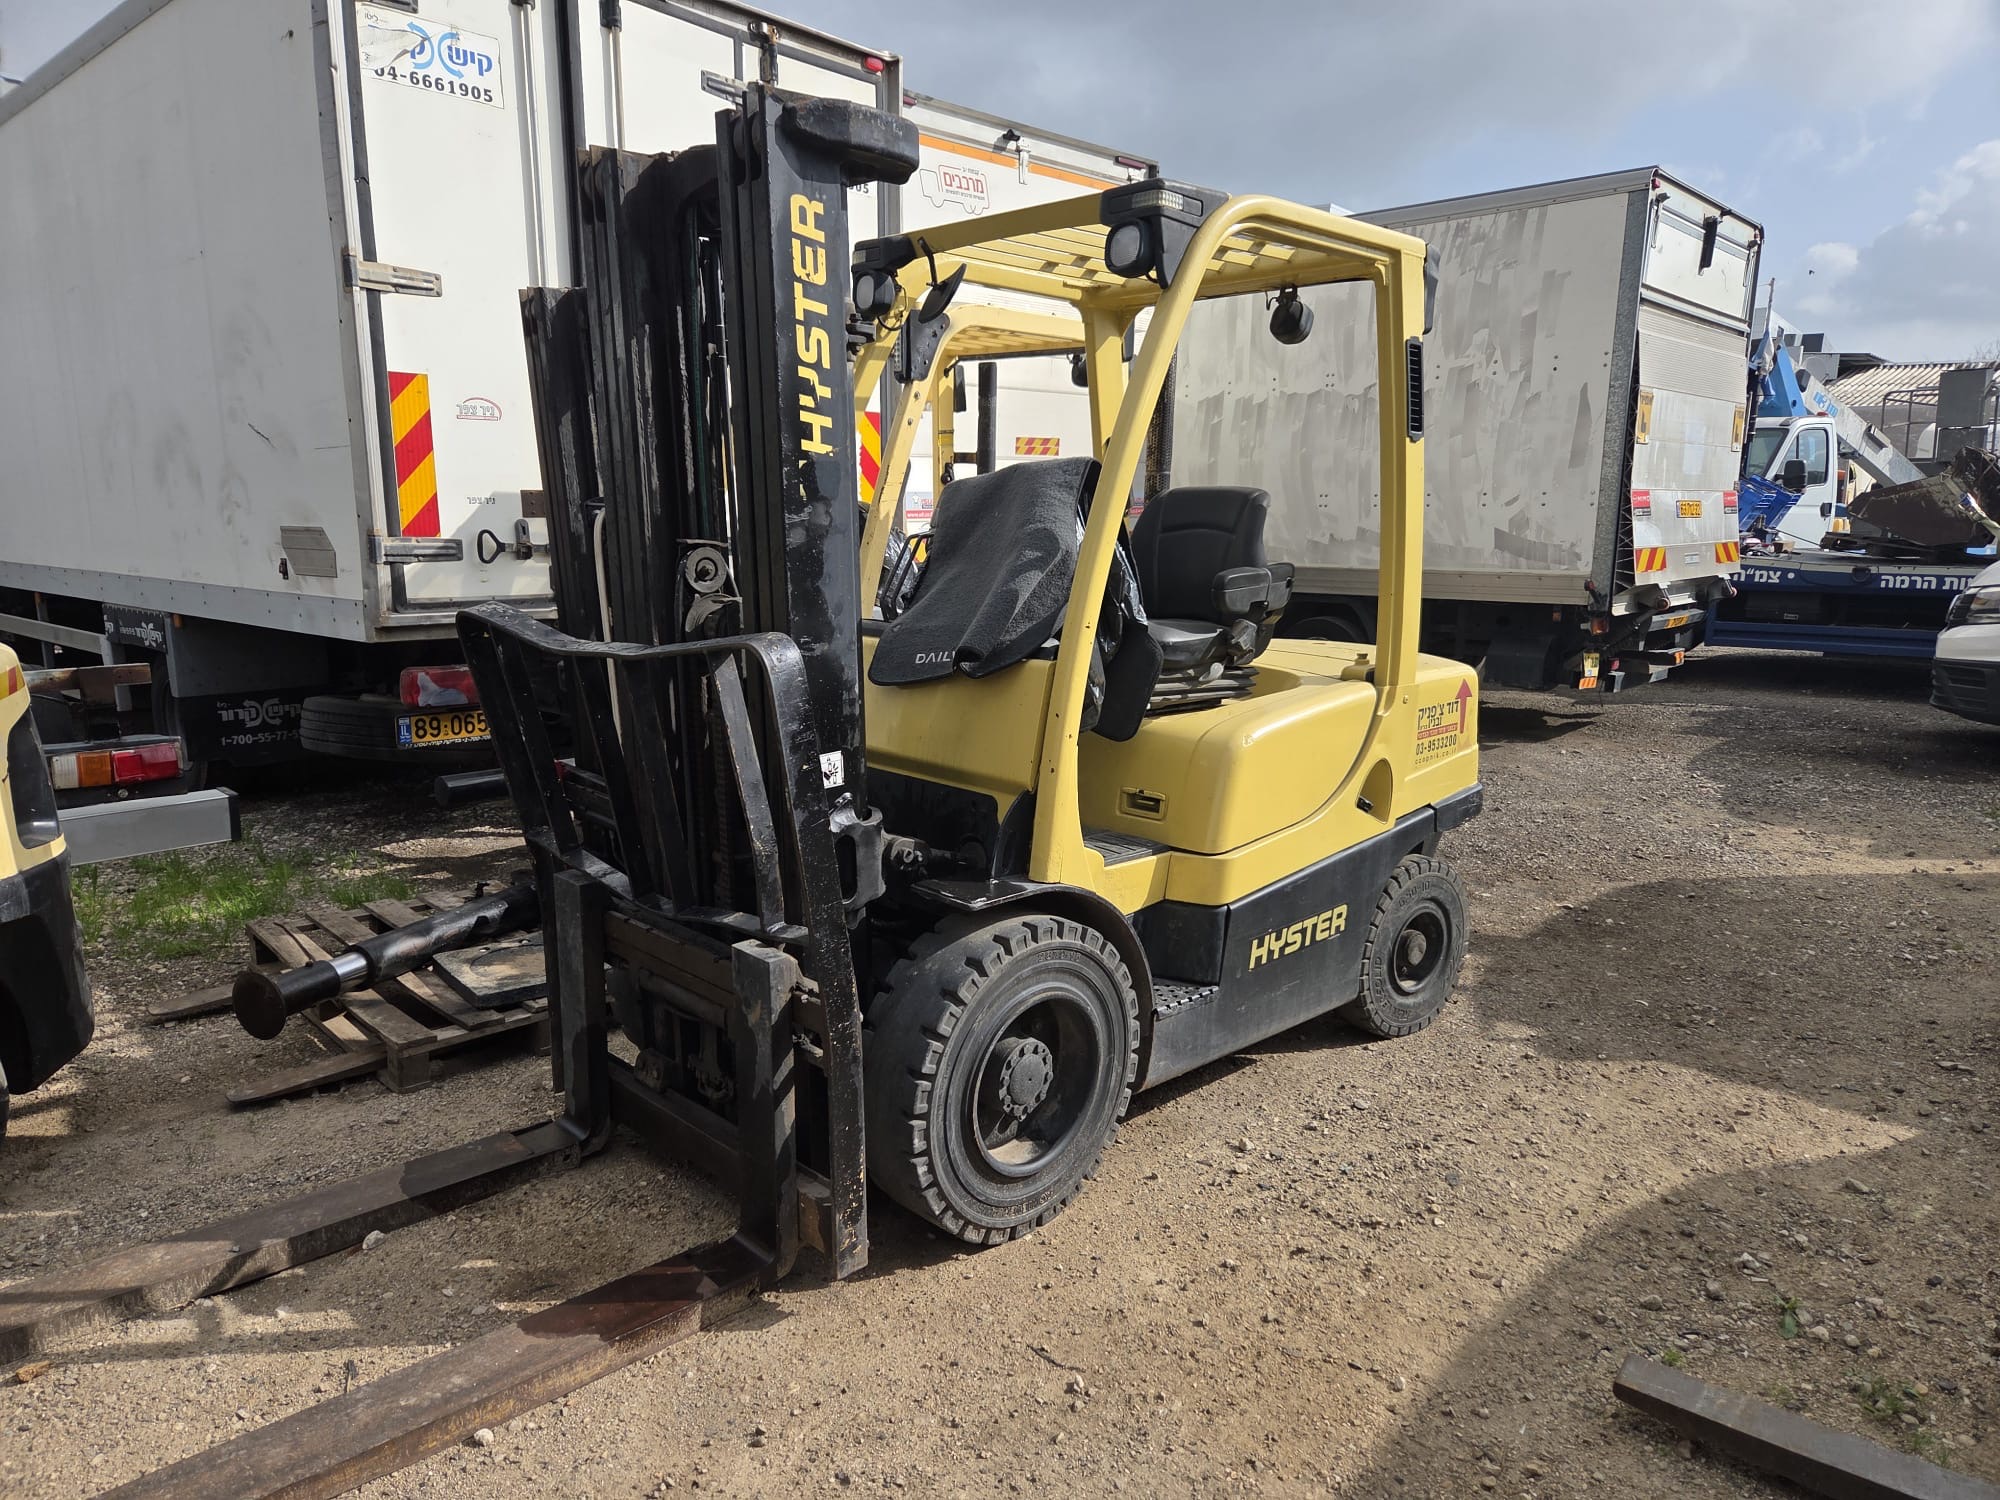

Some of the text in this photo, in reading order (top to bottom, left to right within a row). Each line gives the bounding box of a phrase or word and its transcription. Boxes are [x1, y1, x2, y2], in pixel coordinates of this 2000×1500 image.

[943, 171, 985, 194] מרכבים
[790, 193, 833, 454] HYSTER
[1880, 575, 1937, 590] הרמה
[1415, 734, 1457, 756] 03-9533200
[1249, 904, 1348, 969] HYSTER
